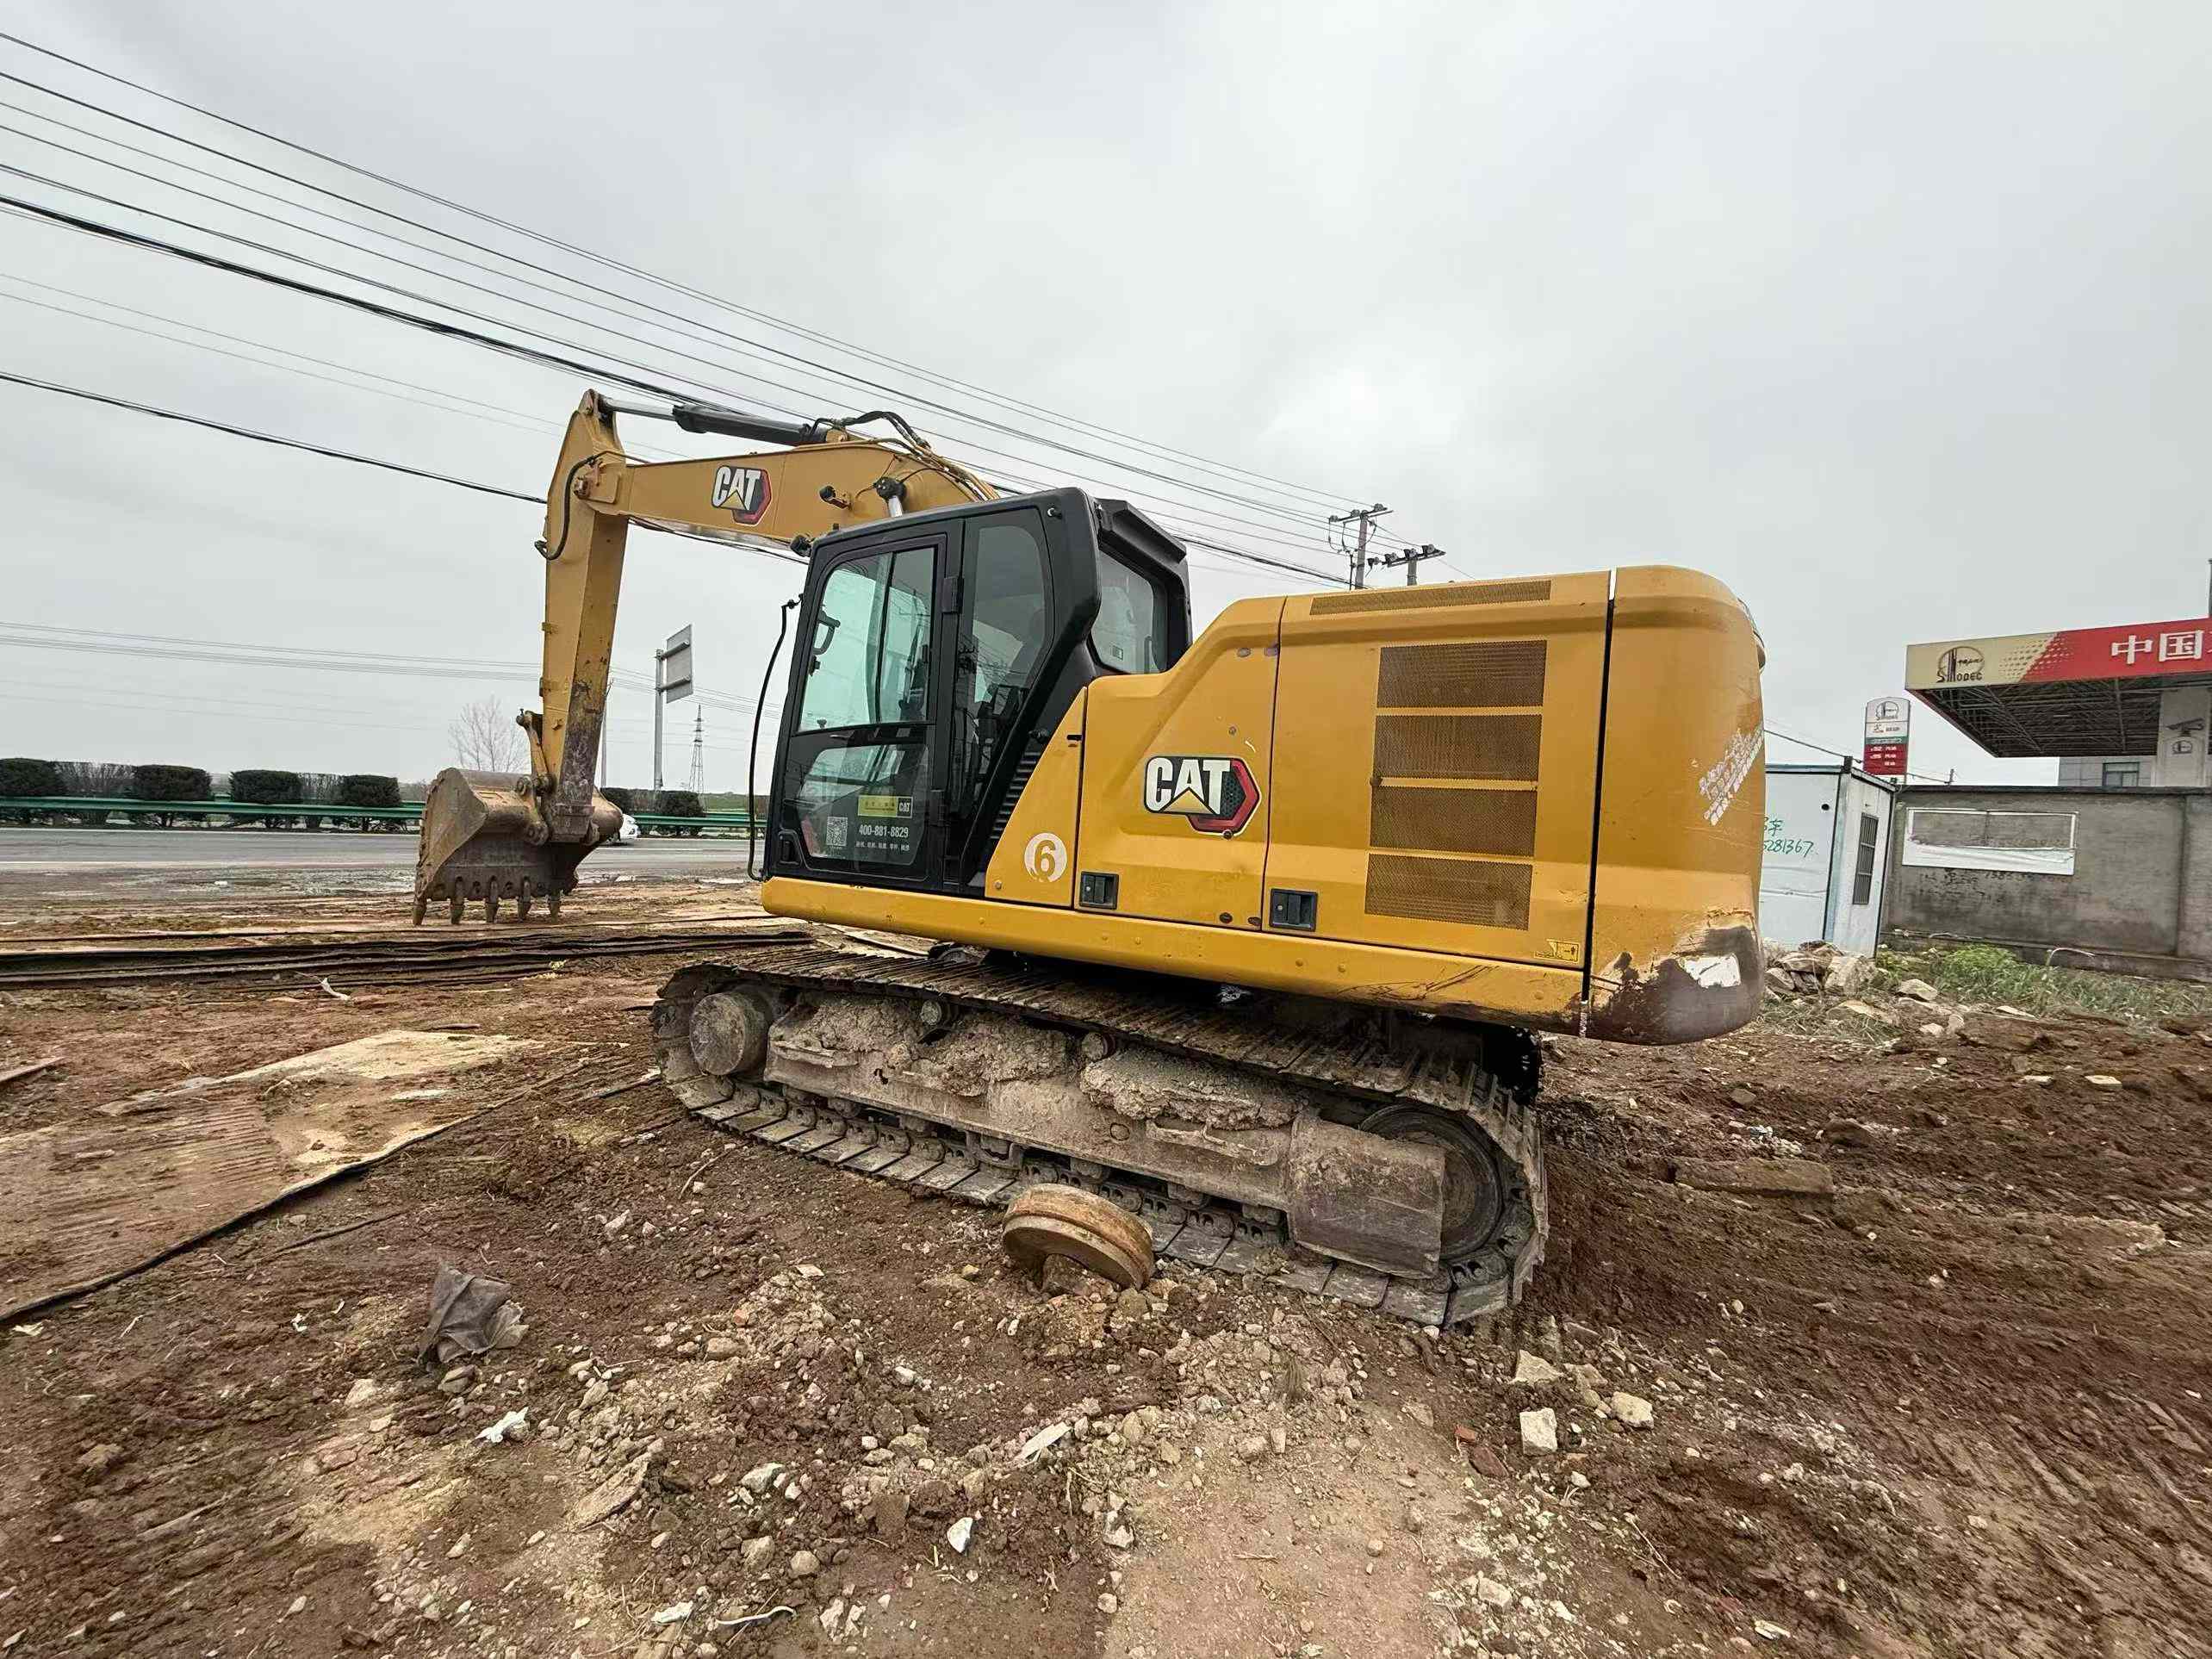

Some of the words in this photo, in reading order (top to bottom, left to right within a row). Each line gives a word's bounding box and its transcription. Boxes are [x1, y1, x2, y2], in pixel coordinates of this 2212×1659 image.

[712, 466, 761, 511] CAT
[2111, 630, 2212, 664] 中国
[1146, 757, 1231, 815] CAT
[898, 802, 910, 812] CAT
[859, 823, 910, 838] 400-881-8829
[1033, 839, 1057, 880] 6
